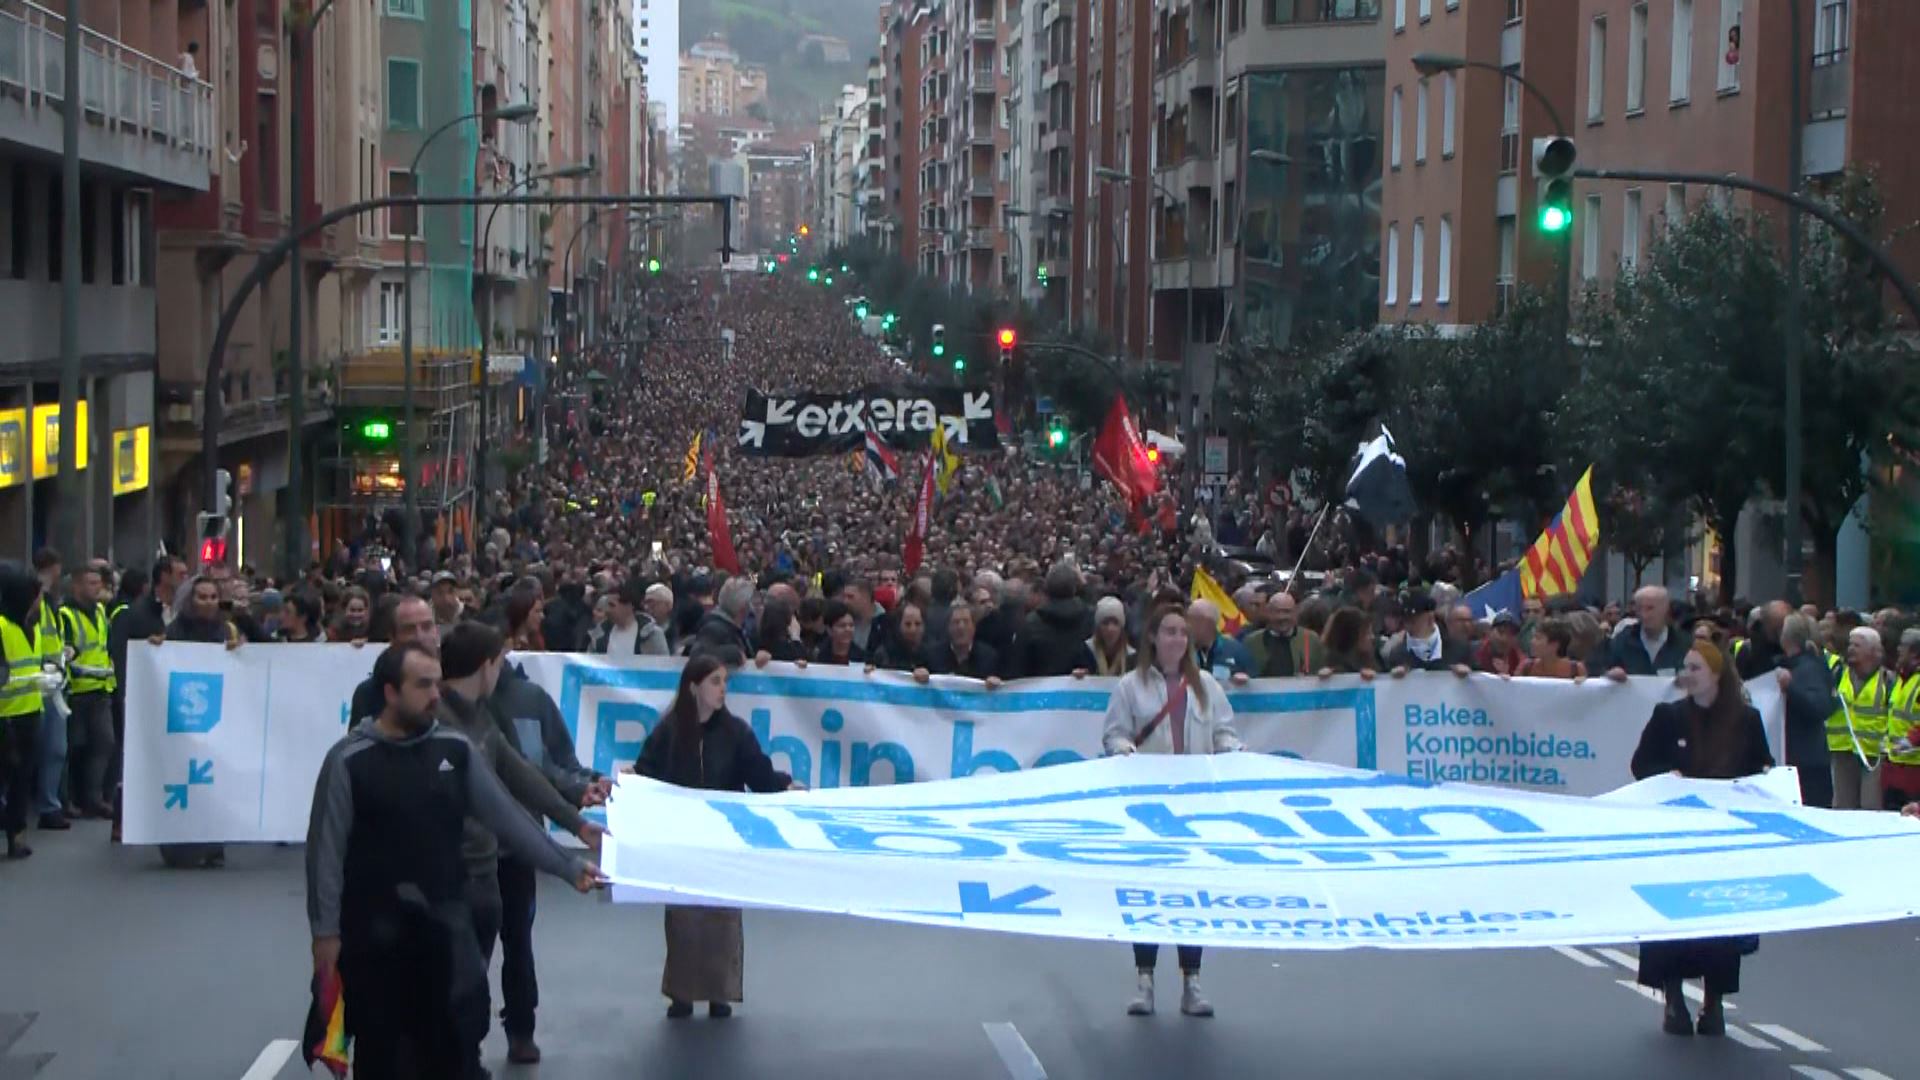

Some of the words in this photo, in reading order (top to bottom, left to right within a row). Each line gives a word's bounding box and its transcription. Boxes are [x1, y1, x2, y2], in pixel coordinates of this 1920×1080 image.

[796, 398, 937, 438] etxera
[1404, 702, 1495, 727] Bakea.
[1405, 732, 1597, 760] Konponbidea.
[1115, 888, 1328, 909] Bakea.
